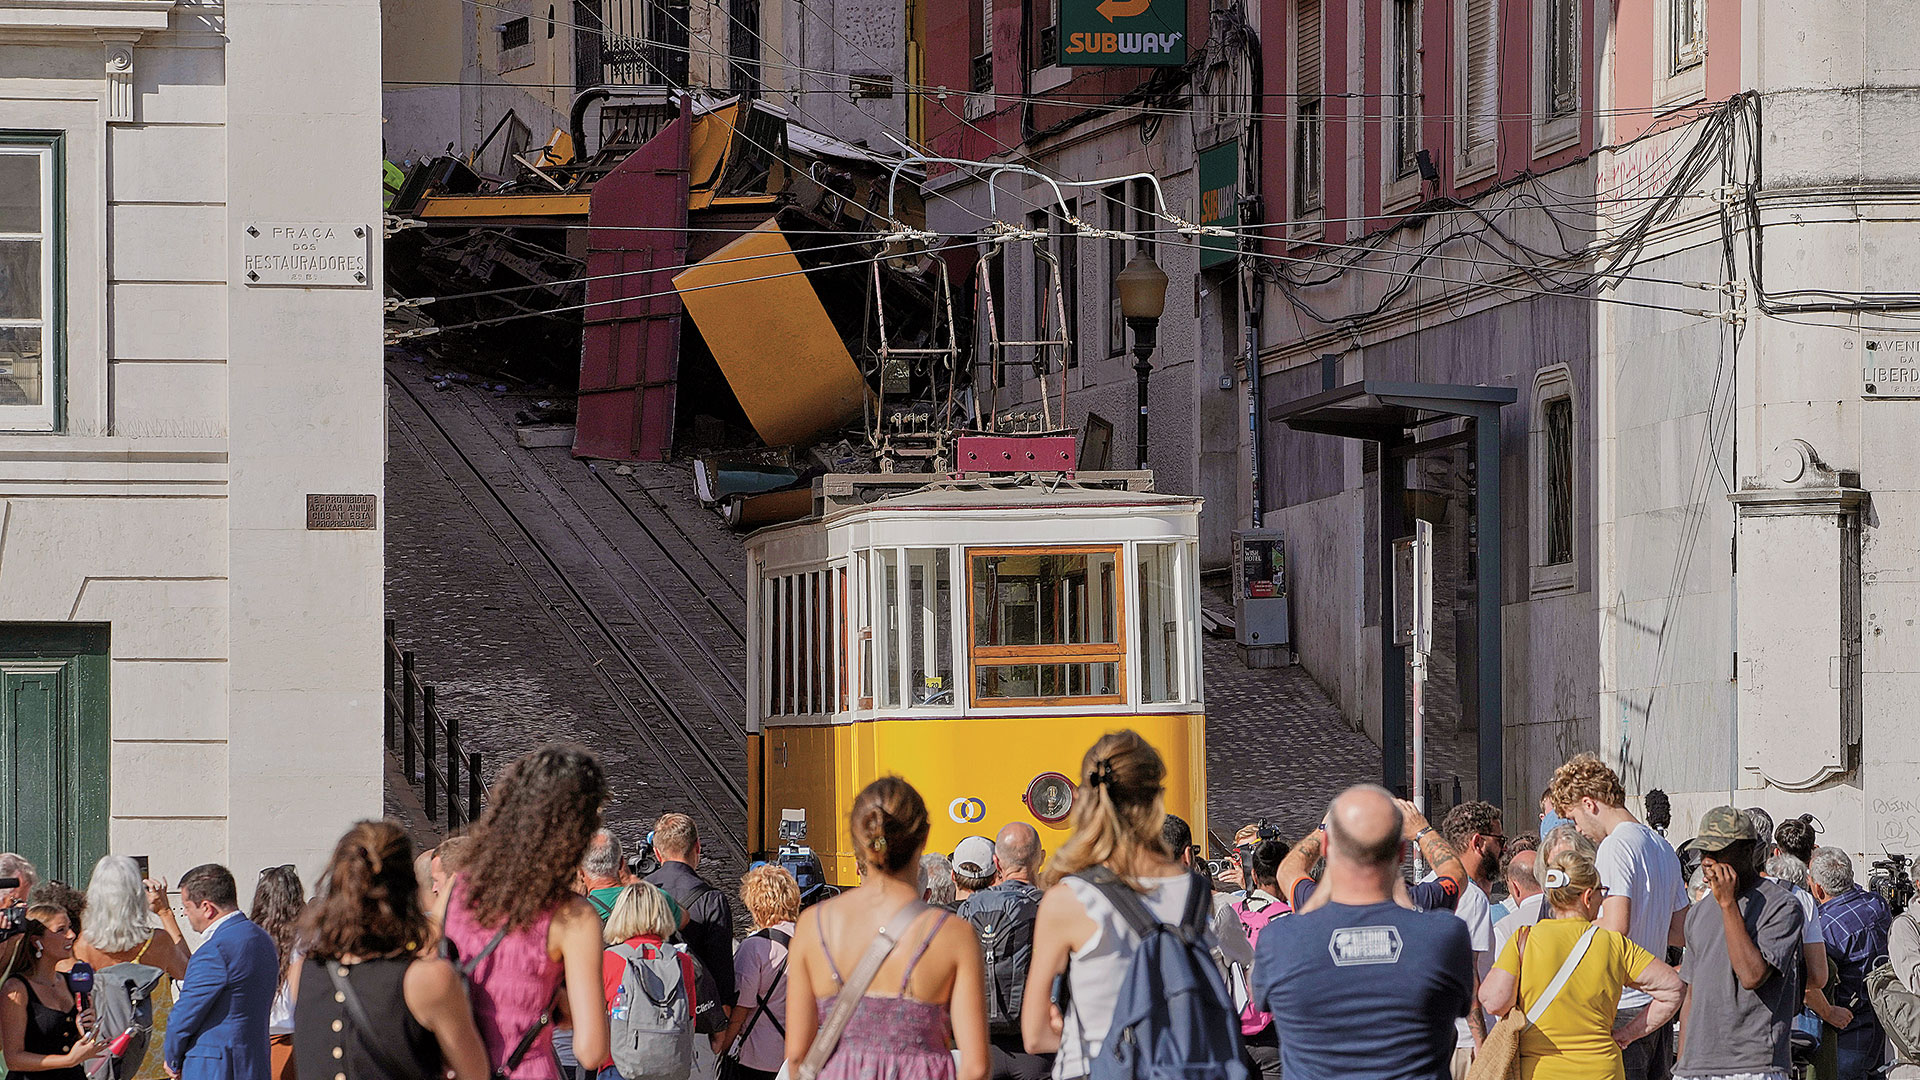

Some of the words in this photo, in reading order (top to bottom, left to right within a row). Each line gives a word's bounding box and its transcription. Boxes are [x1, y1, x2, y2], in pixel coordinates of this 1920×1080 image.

[1065, 31, 1183, 54] SUBWAY
[1201, 183, 1237, 223] SUBWAY
[272, 227, 336, 242] PRAÇA
[292, 243, 317, 251] DOS
[245, 255, 364, 271] RESTAURADORES
[1863, 367, 1919, 382] LIBERD
[349, 512, 371, 520] ESTA
[695, 1000, 715, 1015] Clinic
